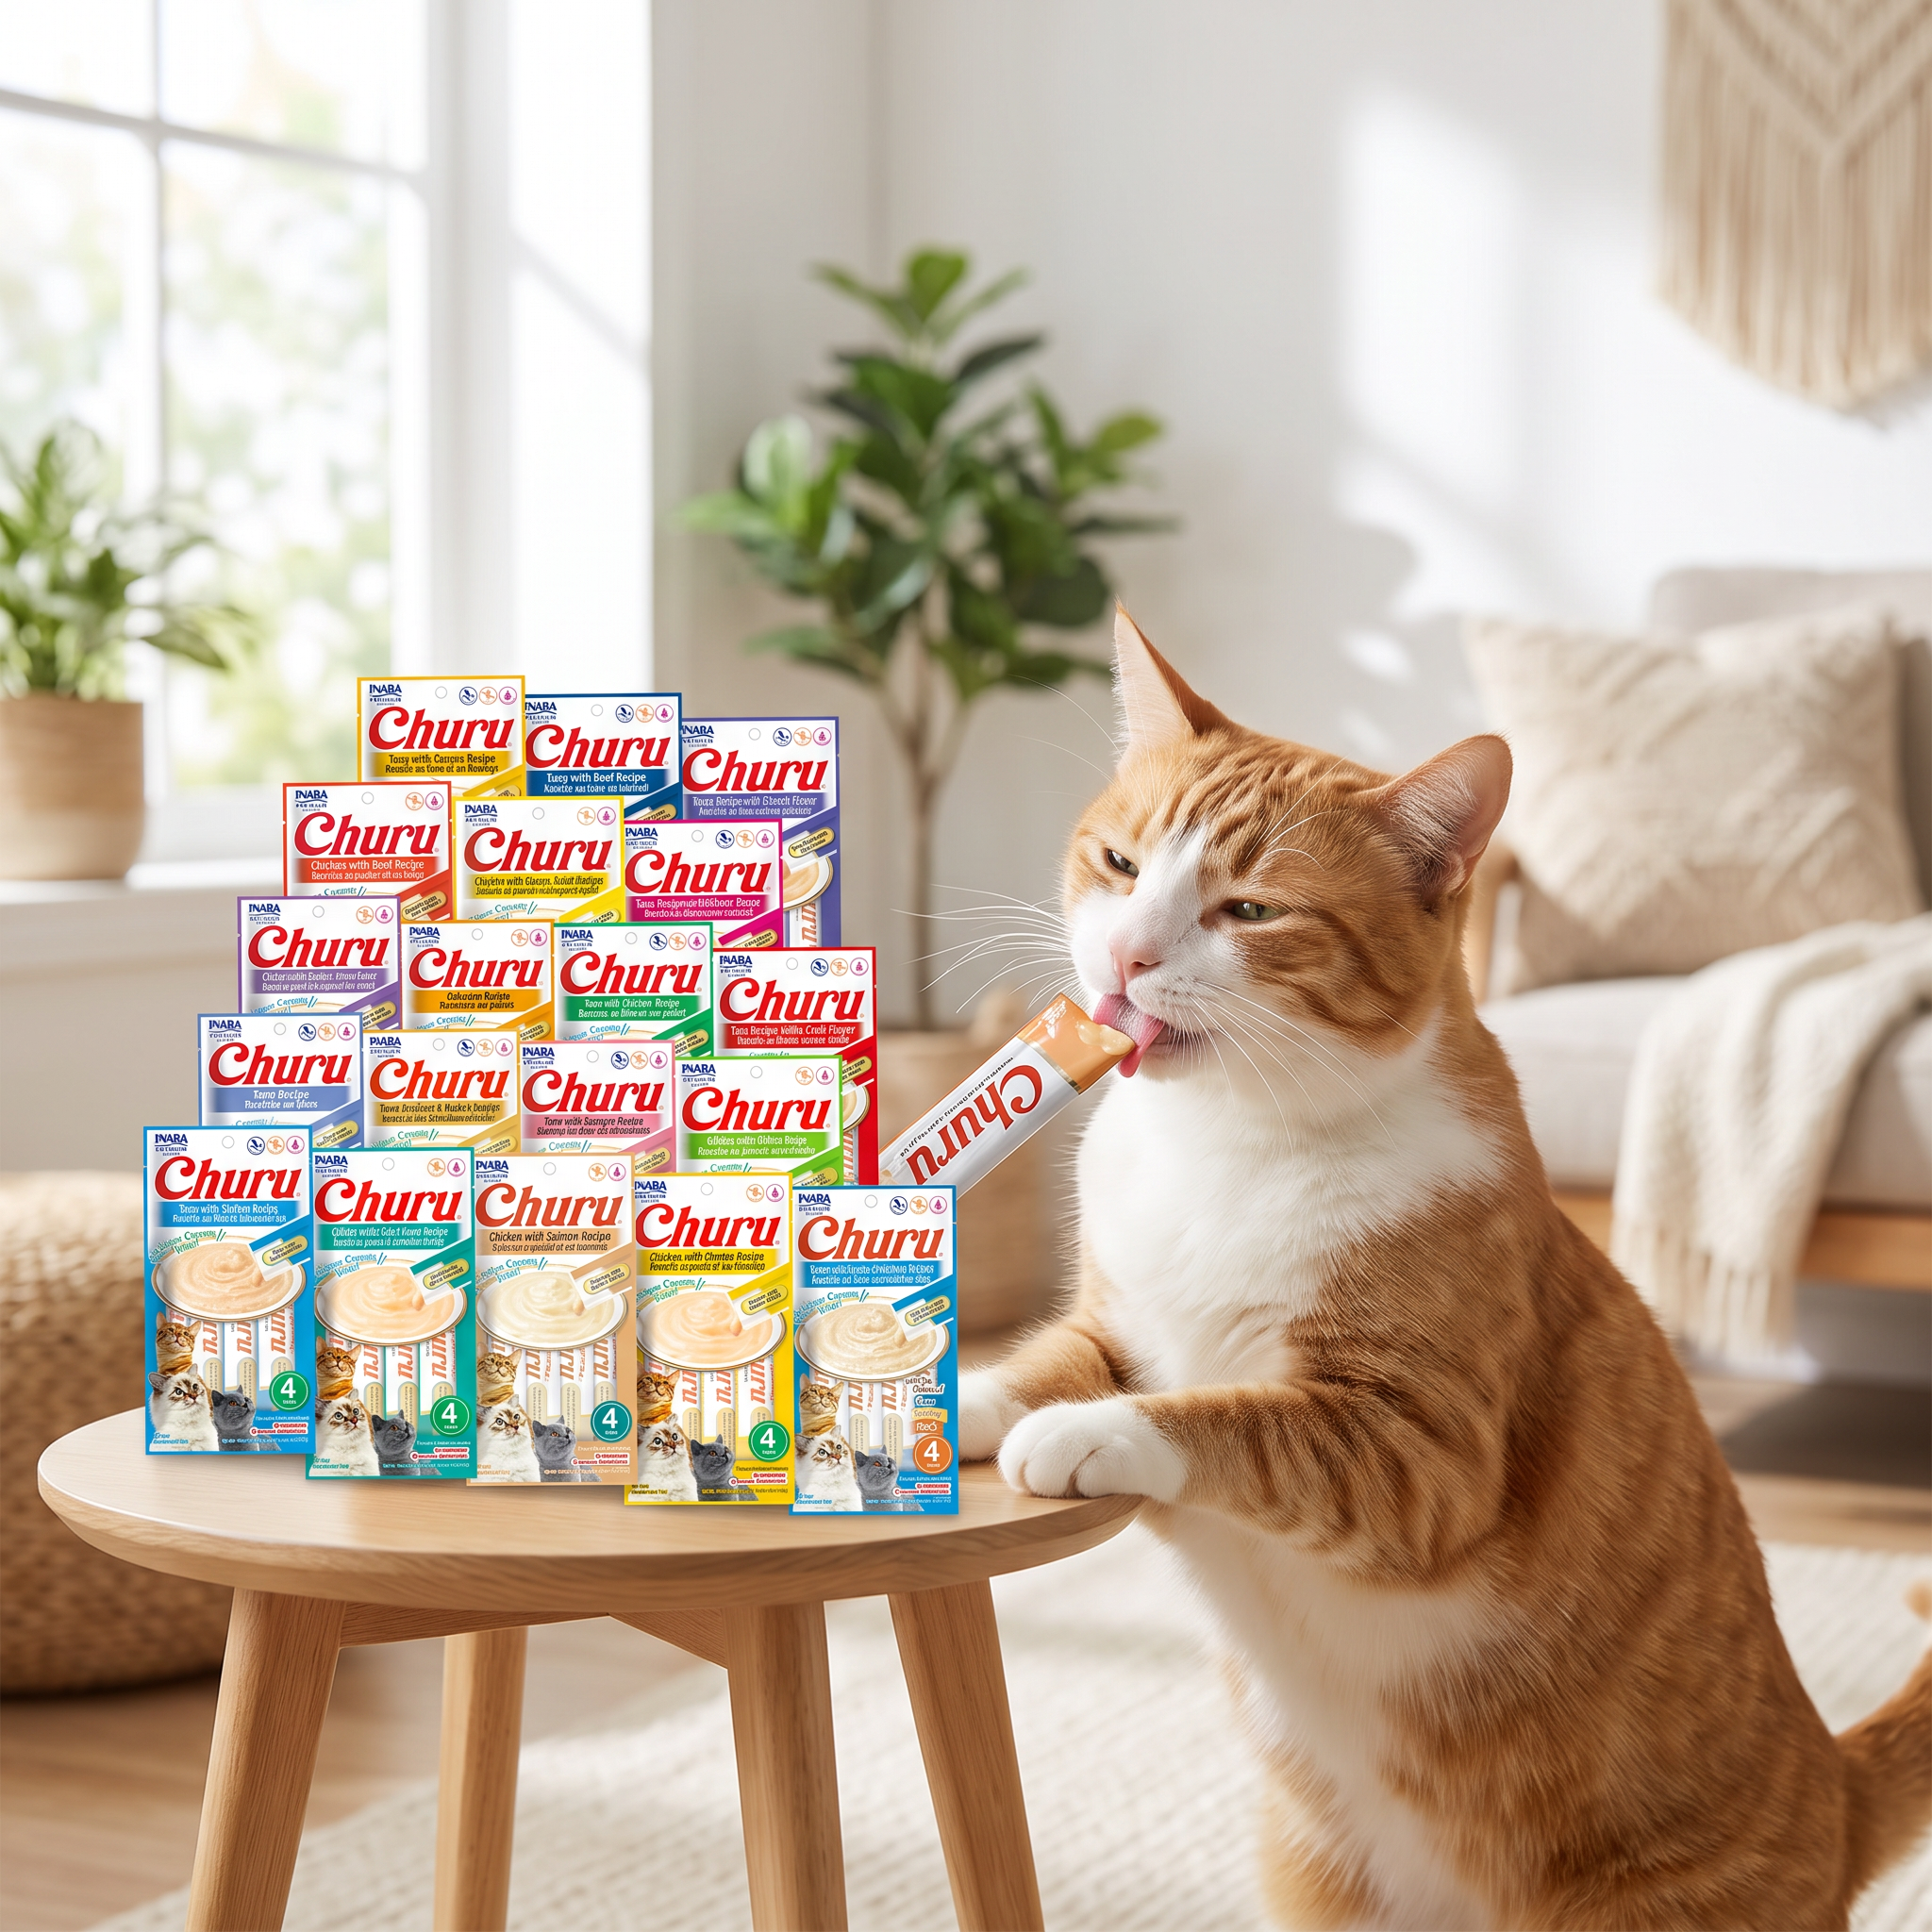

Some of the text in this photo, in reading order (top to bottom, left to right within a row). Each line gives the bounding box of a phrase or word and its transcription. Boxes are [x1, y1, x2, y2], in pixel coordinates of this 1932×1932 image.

[369, 707, 514, 749] Churu
[526, 724, 671, 768] Churu
[616, 774, 646, 783] Recipe
[683, 748, 828, 791] Churu
[294, 812, 441, 856] Churu
[464, 827, 612, 872] Churu
[625, 850, 772, 893] Churu
[248, 925, 390, 968] Churu
[409, 948, 543, 988] Churu
[560, 951, 703, 994] Churu
[720, 977, 865, 1021] Churu
[208, 1042, 352, 1086] Churu
[370, 1058, 509, 1100] Churu
[523, 1070, 664, 1112] Churu
[682, 1087, 831, 1131] Churu
[906, 1065, 1042, 1185] Churu
[155, 1156, 302, 1200] Churu
[315, 1178, 462, 1222] Churu
[475, 1183, 624, 1227] Churu
[490, 1232, 523, 1241] Chicken
[636, 1204, 781, 1248] Churu
[798, 1216, 944, 1260] Churu
[280, 1377, 296, 1398] 4
[441, 1403, 458, 1424] 4
[602, 1407, 618, 1428] 4
[759, 1427, 775, 1448] 4
[924, 1441, 940, 1461] 4
